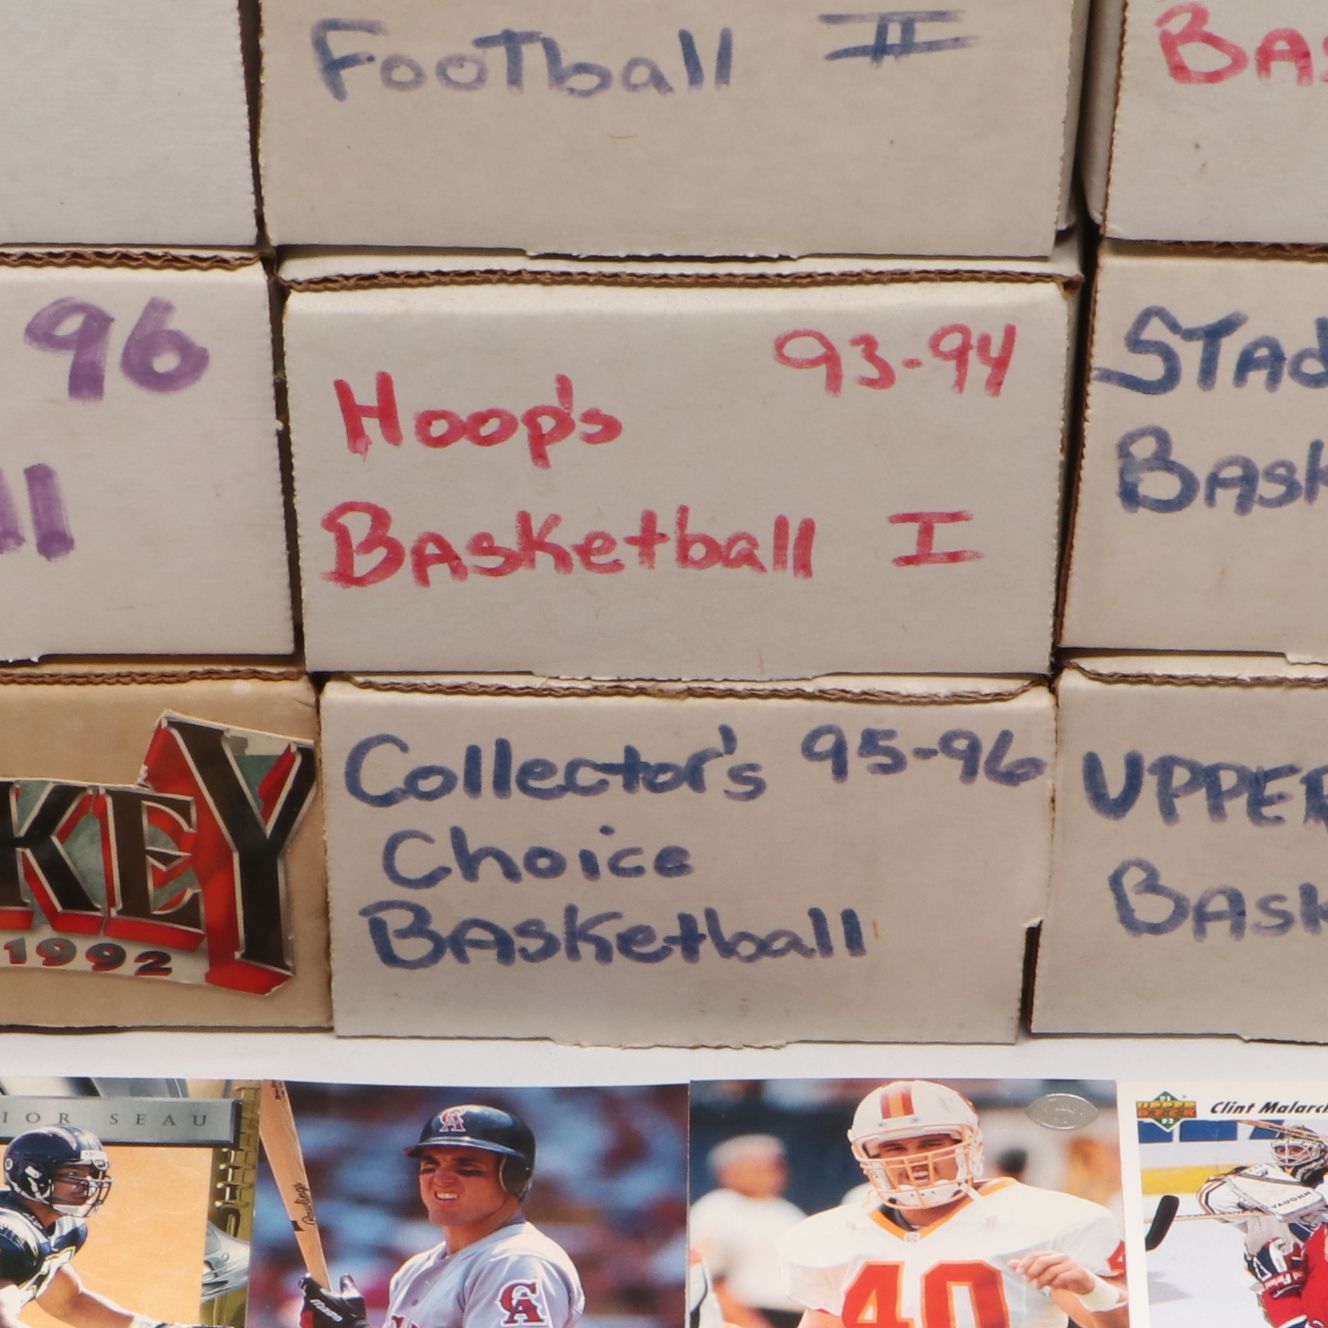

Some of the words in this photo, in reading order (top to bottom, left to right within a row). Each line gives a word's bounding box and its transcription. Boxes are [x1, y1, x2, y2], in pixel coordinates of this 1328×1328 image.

[23, 296, 210, 400] 96
[774, 323, 1018, 397] 93-94
[344, 725, 766, 808] Collector's
[801, 724, 1045, 787] 95-96
[382, 826, 692, 889] Choice
[108, 1111, 209, 1127] SEAU
[1210, 1101, 1255, 1115] Clint
